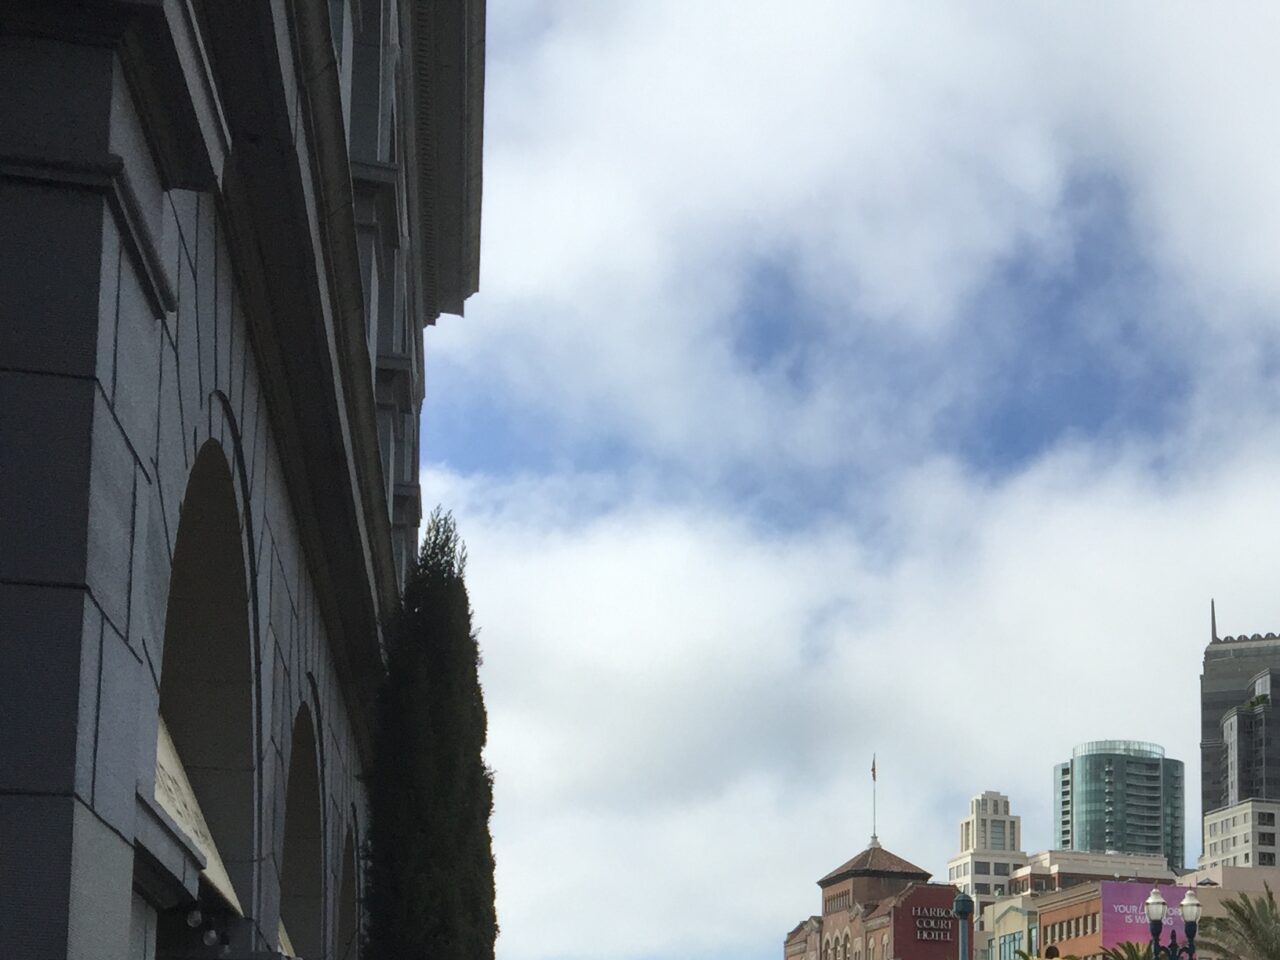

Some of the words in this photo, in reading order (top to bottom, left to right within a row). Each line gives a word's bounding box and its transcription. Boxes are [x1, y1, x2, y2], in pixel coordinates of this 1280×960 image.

[1113, 904, 1138, 914] YOUR
[916, 919, 952, 930] COURT
[1125, 915, 1133, 924] IS
[917, 930, 952, 941] HOTEL
